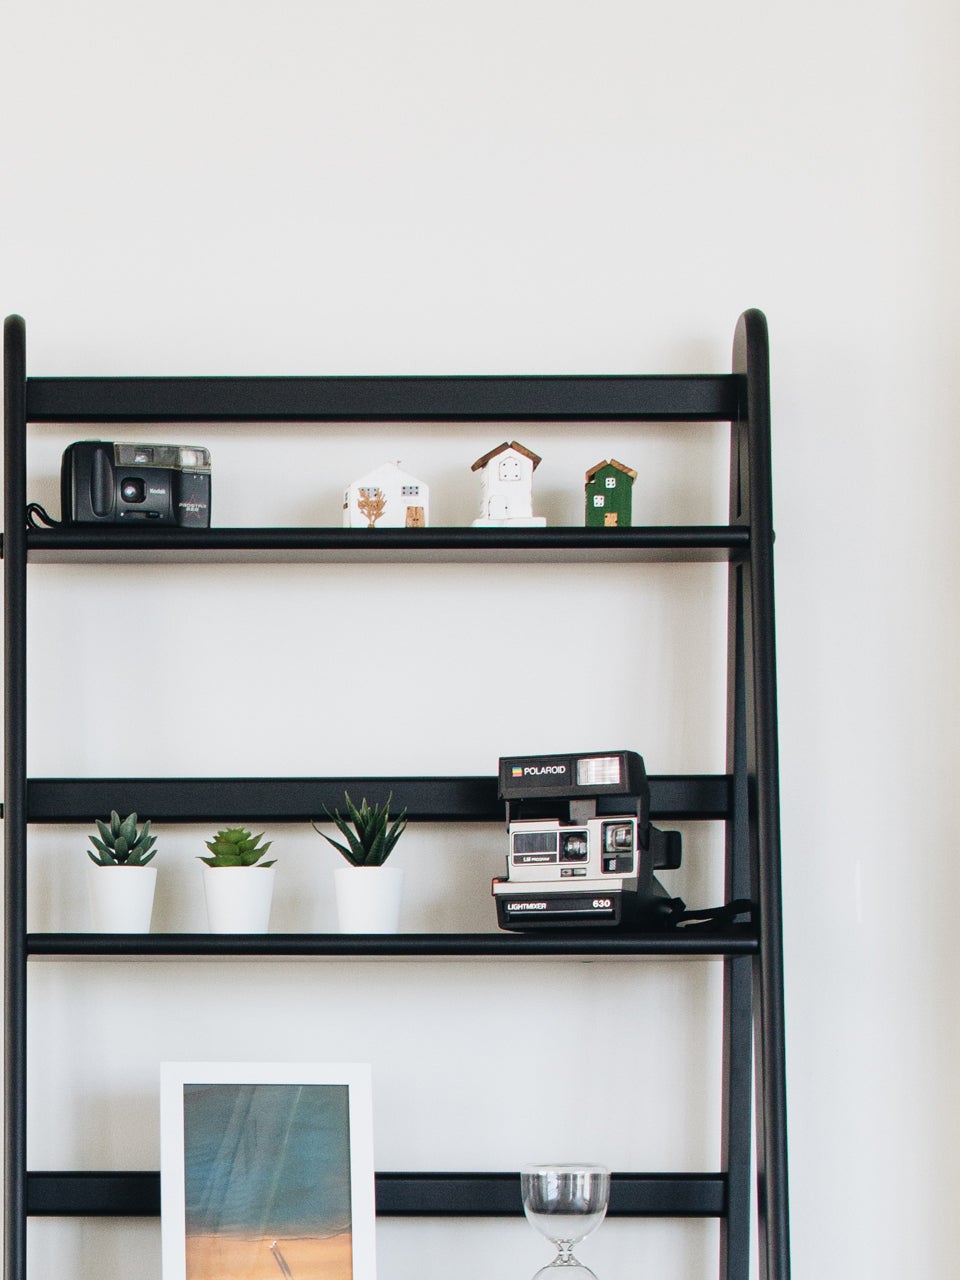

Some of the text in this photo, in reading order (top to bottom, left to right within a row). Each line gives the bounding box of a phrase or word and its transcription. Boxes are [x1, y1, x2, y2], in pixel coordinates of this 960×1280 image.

[523, 765, 566, 776] POLAROID
[507, 899, 611, 911] LIGHTMIXER 630
